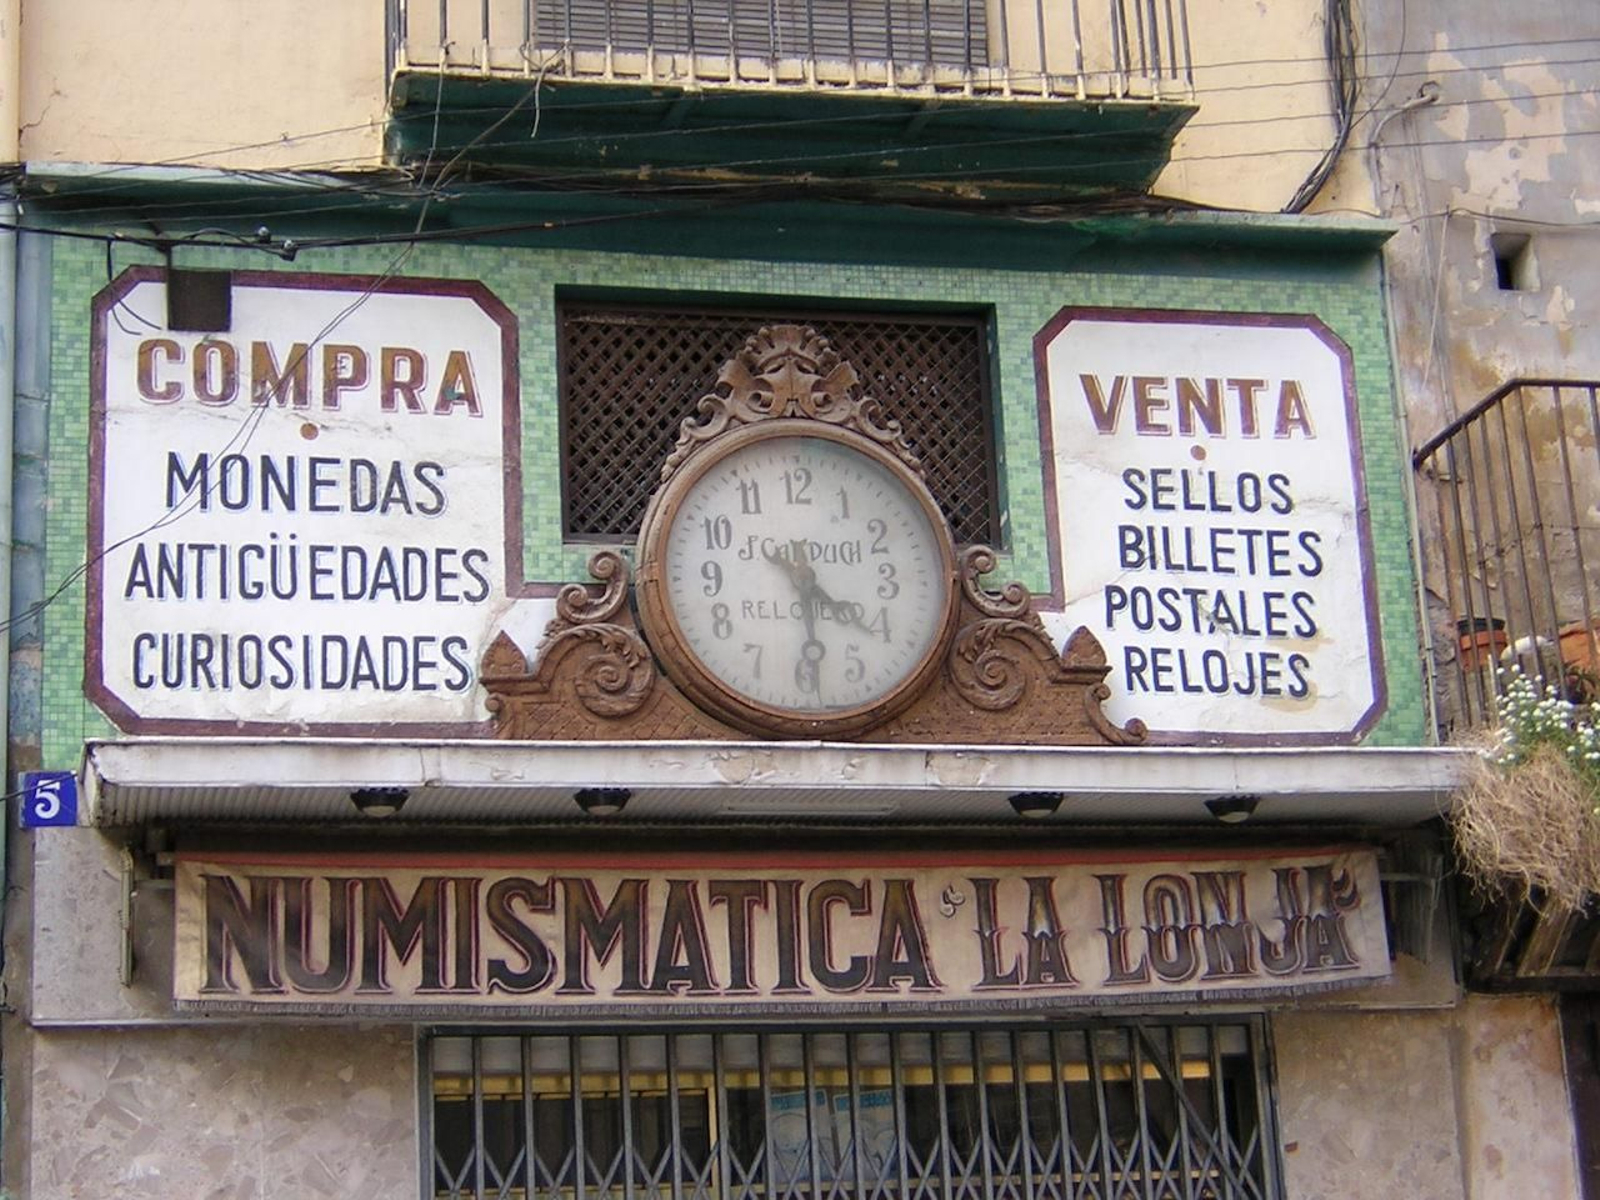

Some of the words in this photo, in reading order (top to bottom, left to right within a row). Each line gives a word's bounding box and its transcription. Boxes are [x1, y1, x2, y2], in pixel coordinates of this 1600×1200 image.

[137, 338, 484, 418] COMPRA
[1079, 374, 1317, 439] VENTA
[165, 451, 448, 515] MONEDAS
[736, 479, 762, 515] 11
[780, 467, 813, 505] 12
[836, 484, 850, 520] 1
[1121, 468, 1294, 515] SELLOS
[700, 514, 733, 550] 10
[867, 519, 890, 554] 2
[1118, 525, 1323, 577] BILLETES
[124, 532, 491, 602] ANTIGÜEDADES
[701, 560, 723, 597] 9
[876, 562, 900, 600] 3
[711, 602, 733, 640] 8
[869, 606, 892, 643] 4
[1105, 585, 1318, 638] POSTALES
[132, 632, 472, 692] CURIOSIDADES
[743, 643, 763, 680] 7
[844, 643, 866, 683] 5
[1123, 645, 1311, 697] RELOJES
[35, 779, 60, 819] 5
[198, 874, 943, 995] NUMISMATICA
